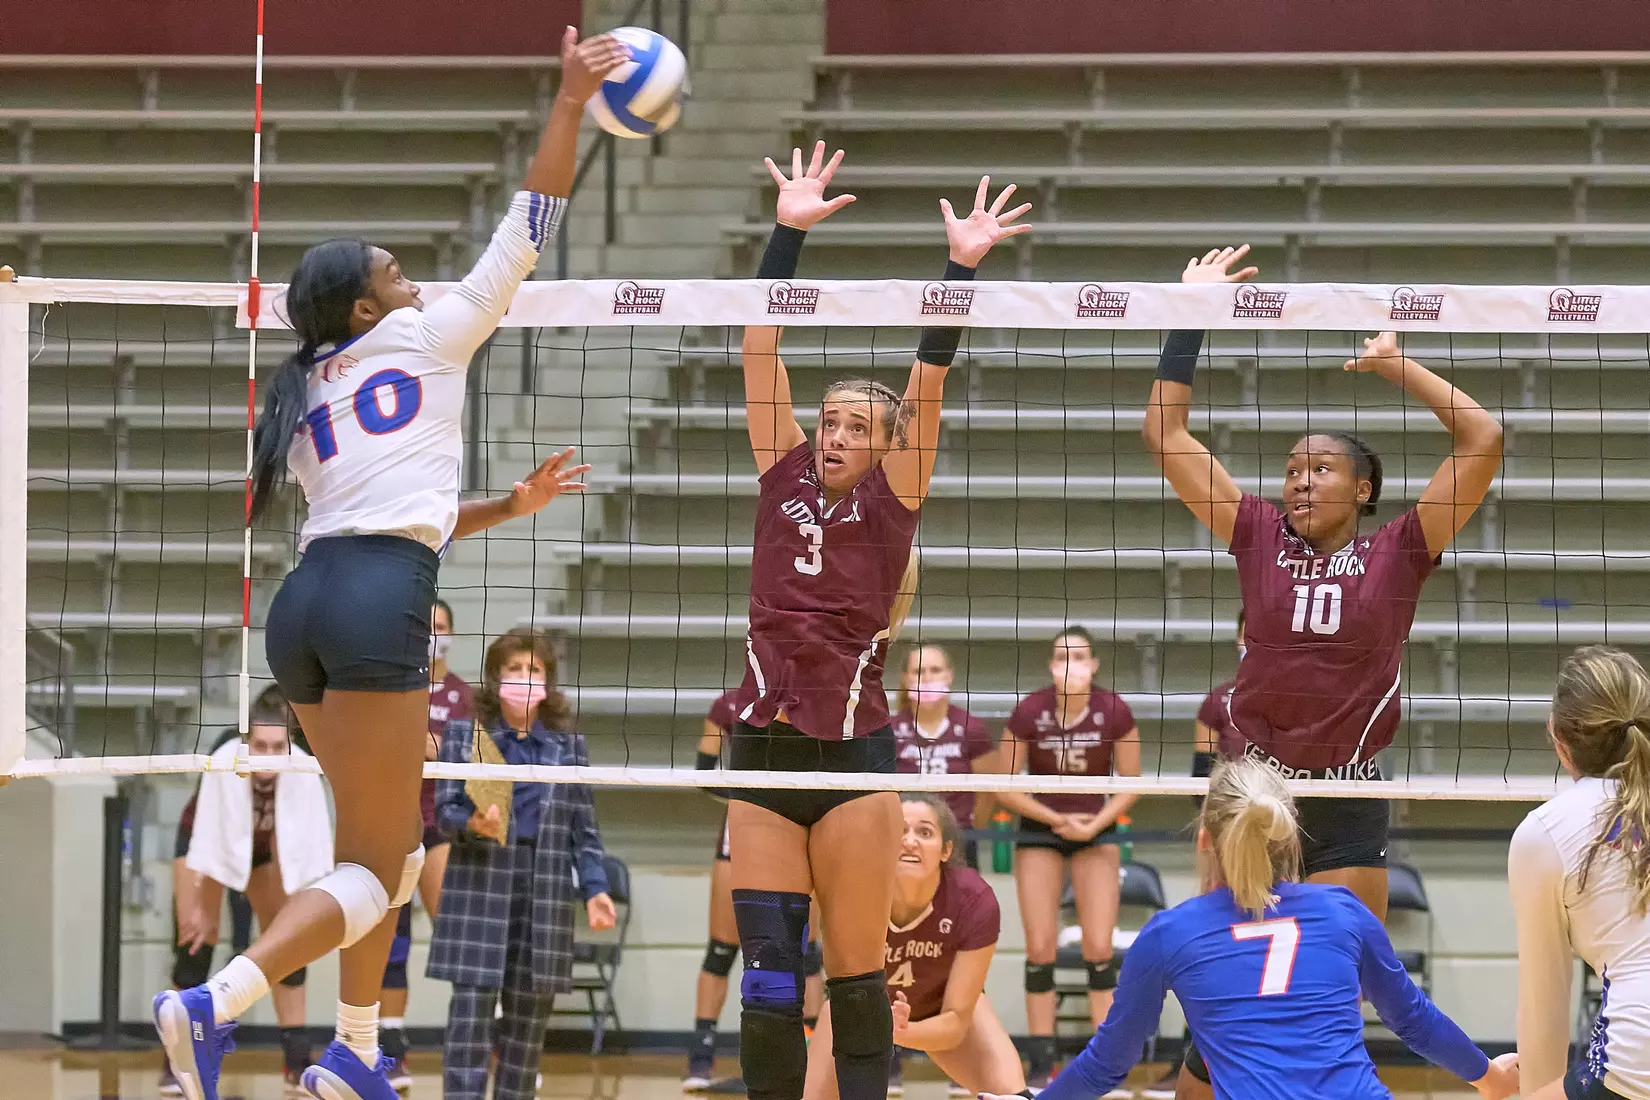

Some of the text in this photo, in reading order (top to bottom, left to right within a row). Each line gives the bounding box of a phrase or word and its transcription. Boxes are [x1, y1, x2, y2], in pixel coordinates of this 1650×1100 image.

[637, 289, 664, 297] LITTLE
[790, 289, 818, 297] LITTLE
[944, 290, 973, 298] LITTLE
[1100, 292, 1129, 300] LITTLE
[1256, 293, 1285, 301] LITTLE
[634, 297, 661, 305] ROCK
[788, 297, 816, 305] ROCK
[942, 298, 971, 306] ROCK
[1098, 300, 1126, 308] ROCK
[1571, 296, 1600, 304] LITTLE
[1255, 301, 1282, 309] ROCK
[1411, 303, 1440, 311] ROCK
[1569, 304, 1598, 312] ROCK
[297, 368, 423, 465] 10
[794, 523, 823, 575] 3
[1325, 555, 1365, 578] ROCK
[1291, 583, 1342, 635] 10
[1054, 748, 1088, 772] 15
[1325, 757, 1376, 781] NIKE
[905, 940, 943, 958] ROCK
[1230, 916, 1301, 996] 7
[887, 960, 916, 987] 4
